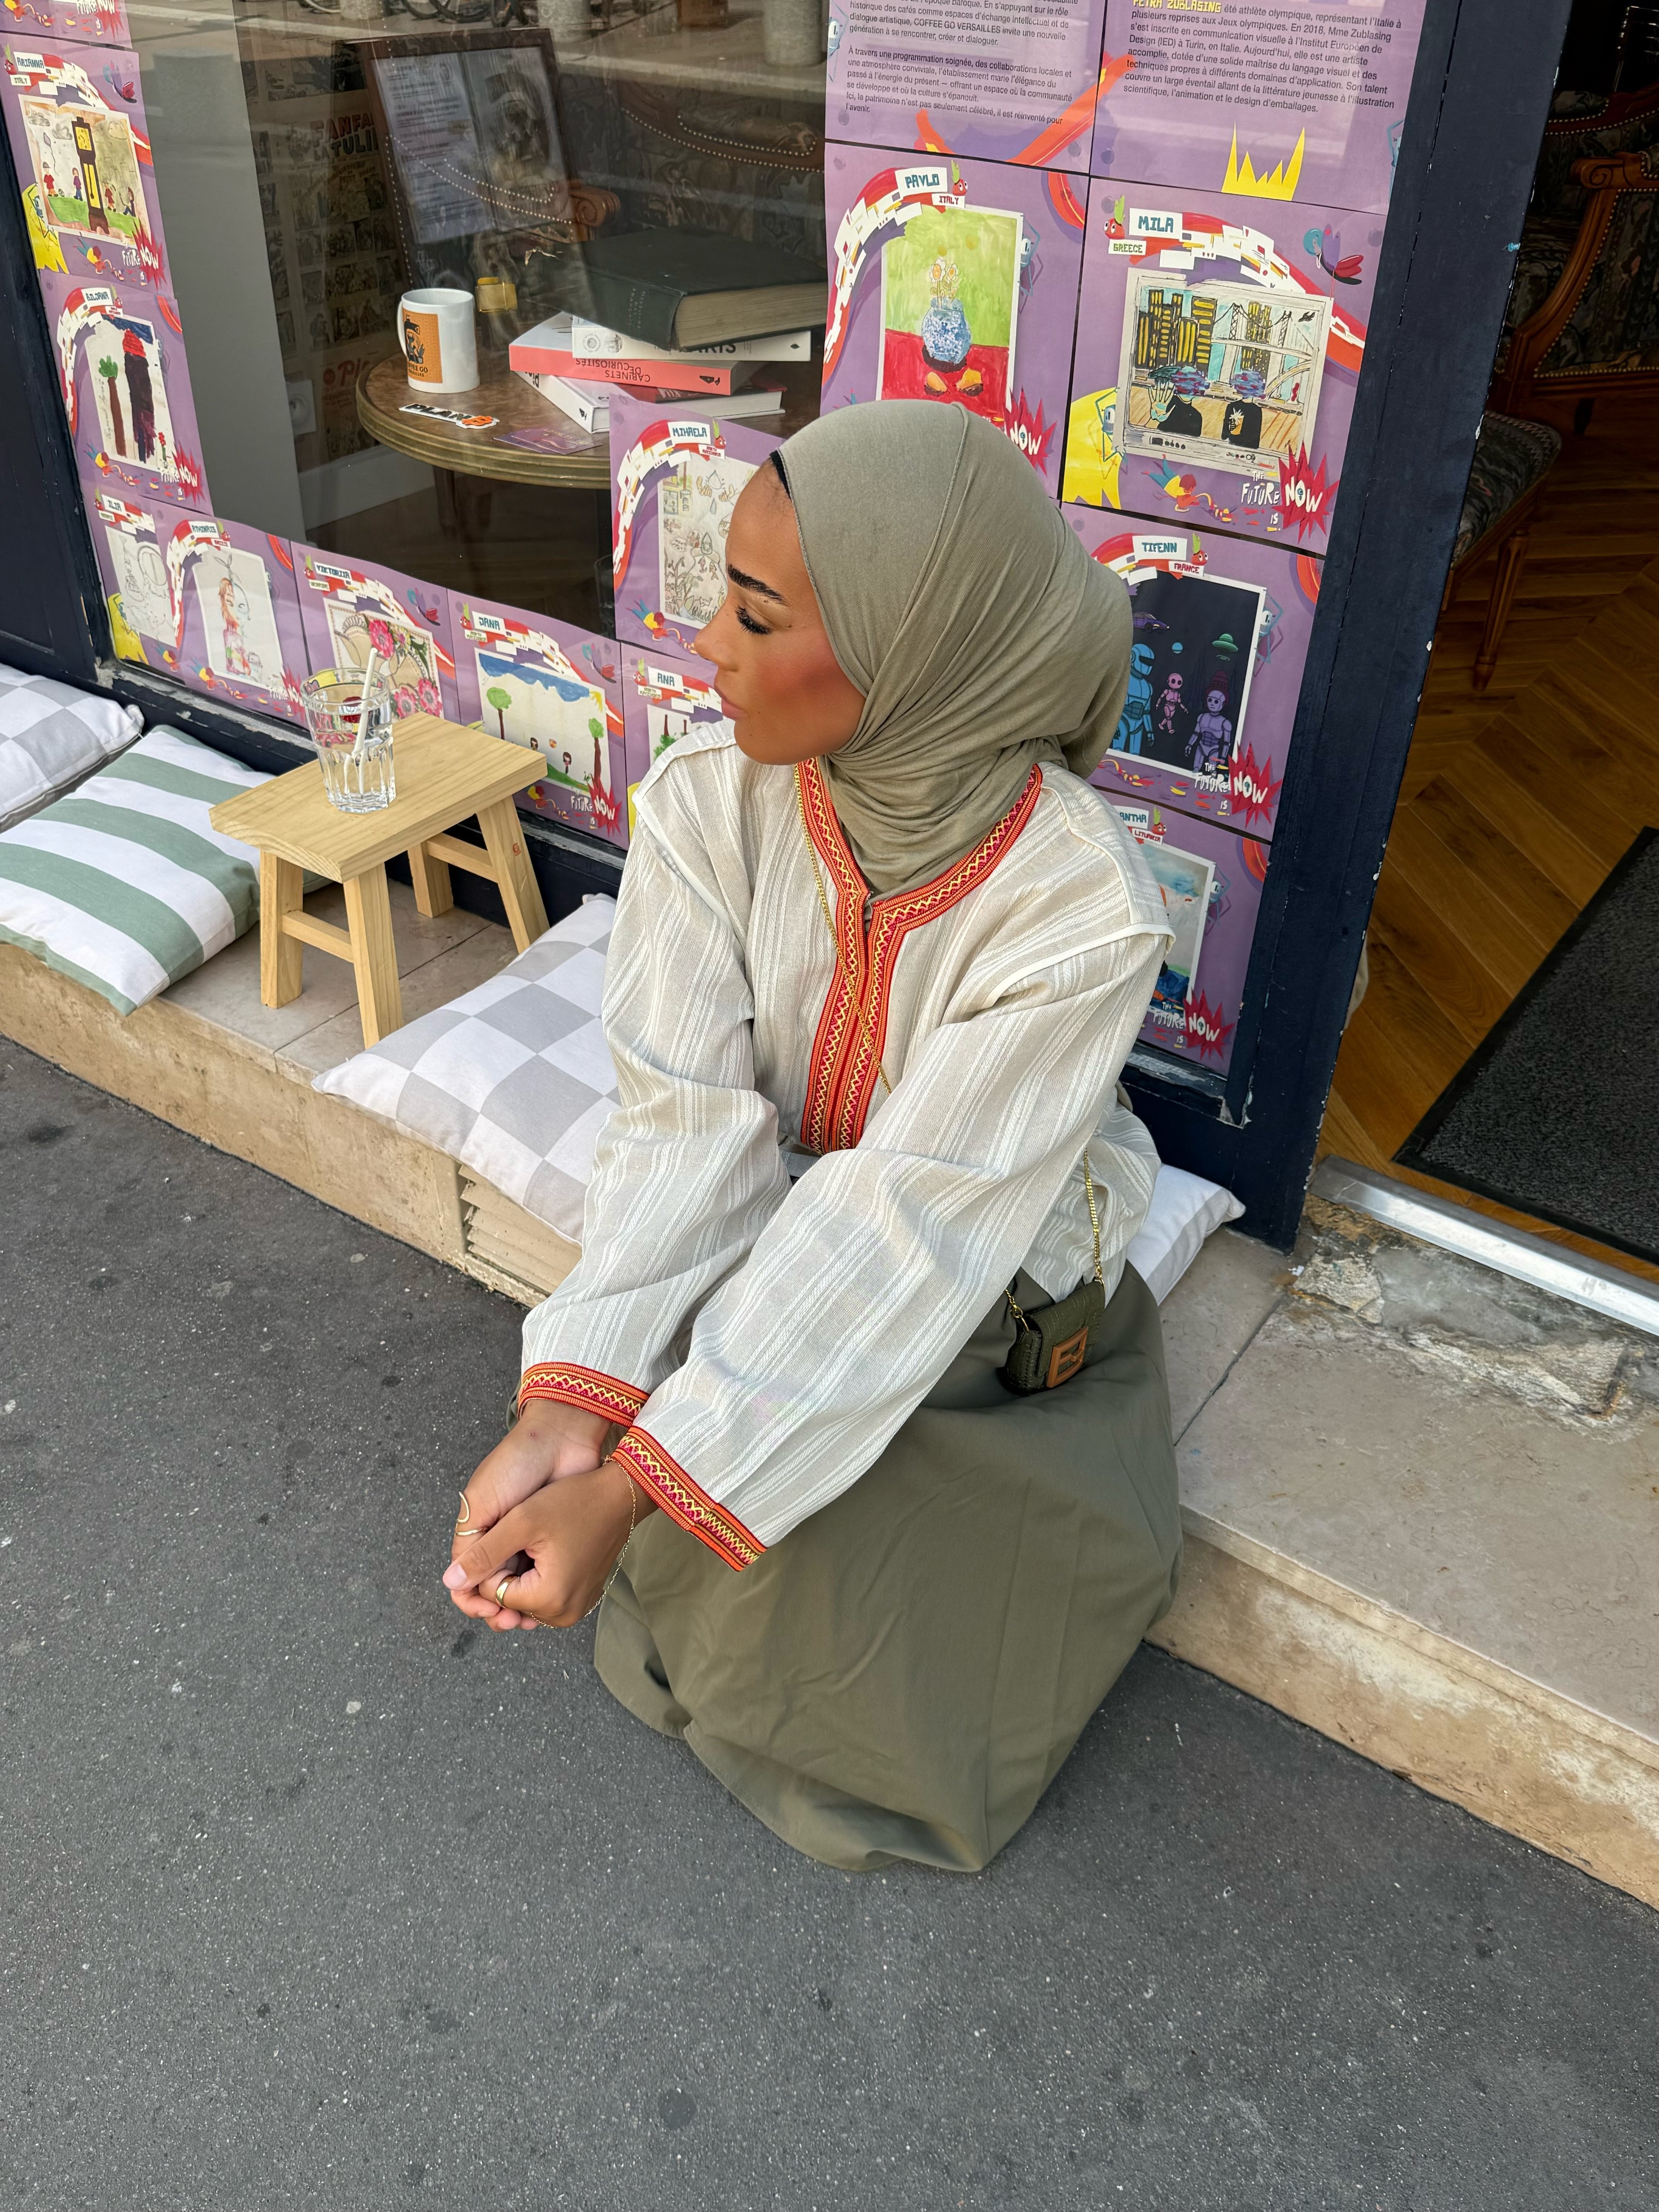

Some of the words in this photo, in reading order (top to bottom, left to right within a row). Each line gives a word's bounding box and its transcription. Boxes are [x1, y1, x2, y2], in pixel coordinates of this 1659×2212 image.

[849, 12, 877, 23] dialogue
[879, 16, 912, 26] artistique,
[913, 18, 943, 28] COFFEE
[944, 20, 955, 29] GO
[957, 22, 1001, 33] VERSAILLES
[1002, 27, 1020, 36] invite
[1036, 32, 1065, 40] nouvelle
[1131, 9, 1166, 20] plusieurs
[1168, 14, 1199, 23] reprises
[1218, 17, 1237, 26] Jeux
[1239, 19, 1287, 31] olympiques.
[1290, 22, 1301, 32] En
[1328, 26, 1348, 36] Mme
[1350, 29, 1391, 43] Zublasing
[1166, 0, 1222, 13] ZUBLASING
[1224, 4, 1237, 13] été
[1238, 6, 1266, 16] athlète
[1268, 8, 1313, 21] olympique,
[1315, 13, 1367, 25] représentant
[1369, 17, 1394, 28] l'Italie
[1395, 19, 1401, 29] à
[1130, 22, 1148, 32] s'est
[1150, 24, 1179, 34] inscrite
[1192, 29, 1253, 41] communication
[1255, 33, 1286, 44] visuelle
[1287, 35, 1293, 44] à
[1295, 36, 1328, 48] l'Institut
[1371, 44, 1382, 53] de
[848, 44, 853, 54] À
[855, 48, 877, 57] travers
[893, 52, 943, 64] programmation
[945, 57, 973, 67] soignée,
[975, 59, 988, 68] des
[989, 61, 1037, 73] collaborations
[1039, 66, 1063, 76] locales
[1129, 34, 1155, 46] Design
[1157, 37, 1176, 48] (IED)
[1178, 38, 1182, 47] à
[1185, 39, 1205, 50] Turin,
[1220, 42, 1241, 53] Italie.
[1243, 44, 1291, 59] Aujourd'hui,
[1294, 50, 1308, 59] elle
[1310, 52, 1323, 61] est
[1342, 55, 1368, 65] artiste
[861, 60, 900, 70] atmosphère
[902, 65, 937, 75] conviviale,
[938, 67, 988, 80] l'établissement
[990, 74, 1009, 83] marie
[1011, 75, 1046, 86] l'élégance
[1047, 79, 1056, 88] du
[1128, 48, 1169, 60] accomplie,
[1171, 51, 1193, 61] dotée
[1195, 54, 1217, 64] d'une
[1220, 56, 1243, 66] solide
[1245, 59, 1277, 69] maîtrise
[1279, 61, 1290, 70] du
[1292, 62, 1324, 75] langage
[1326, 67, 1350, 76] visuel
[1351, 70, 1360, 78] et
[1362, 70, 1377, 79] des
[1127, 59, 1168, 71] techniques
[1170, 65, 1200, 74] propres
[1201, 66, 1207, 75] à
[1209, 67, 1246, 79] différents
[1248, 71, 1287, 83] domaines
[1289, 76, 1343, 89] d'application.
[1346, 81, 1362, 91] Son
[1364, 84, 1388, 94] talent
[1123, 84, 1169, 97] scientifique,
[1171, 89, 1213, 101] l'animation
[1225, 94, 1232, 102] le
[1234, 95, 1261, 107] design
[1262, 99, 1318, 113] d'emballages.
[1125, 73, 1150, 81] couvre
[1164, 75, 1183, 86] large
[1185, 77, 1216, 88] éventail
[1217, 81, 1239, 91] allant
[1241, 83, 1251, 92] de
[1253, 84, 1260, 93] la
[1262, 85, 1300, 98] littérature
[1302, 89, 1338, 102] jeunesse
[1340, 94, 1345, 102] à
[1348, 95, 1394, 108] l'illustration
[905, 173, 940, 188] PAVLO
[938, 195, 960, 205] ITALY
[1138, 216, 1174, 233] MILA
[140, 243, 159, 270] NOW
[1112, 242, 1143, 254] GREECE
[575, 358, 630, 371] CURIOSITÉS
[604, 369, 651, 383] CABINETS
[628, 366, 641, 375] DE
[672, 426, 708, 437] MIHAELA
[1010, 420, 1042, 455] NOW
[178, 463, 197, 487] NOW
[1252, 470, 1265, 482] THE
[1240, 482, 1281, 505] FUTURE
[1284, 476, 1323, 513] NOW
[1270, 512, 1279, 525] IS
[1141, 542, 1177, 553] TIFENN
[1174, 563, 1200, 574] FRANCE
[657, 672, 675, 687] ANA
[1204, 762, 1216, 772] THE
[1195, 772, 1230, 793] FUTURE
[1233, 771, 1268, 804] NOW
[570, 795, 593, 812] FUTURE
[594, 795, 616, 820] NOW
[1220, 801, 1228, 810] IS
[1153, 1011, 1185, 1029] FUTURE
[1188, 1012, 1220, 1042] NOW
